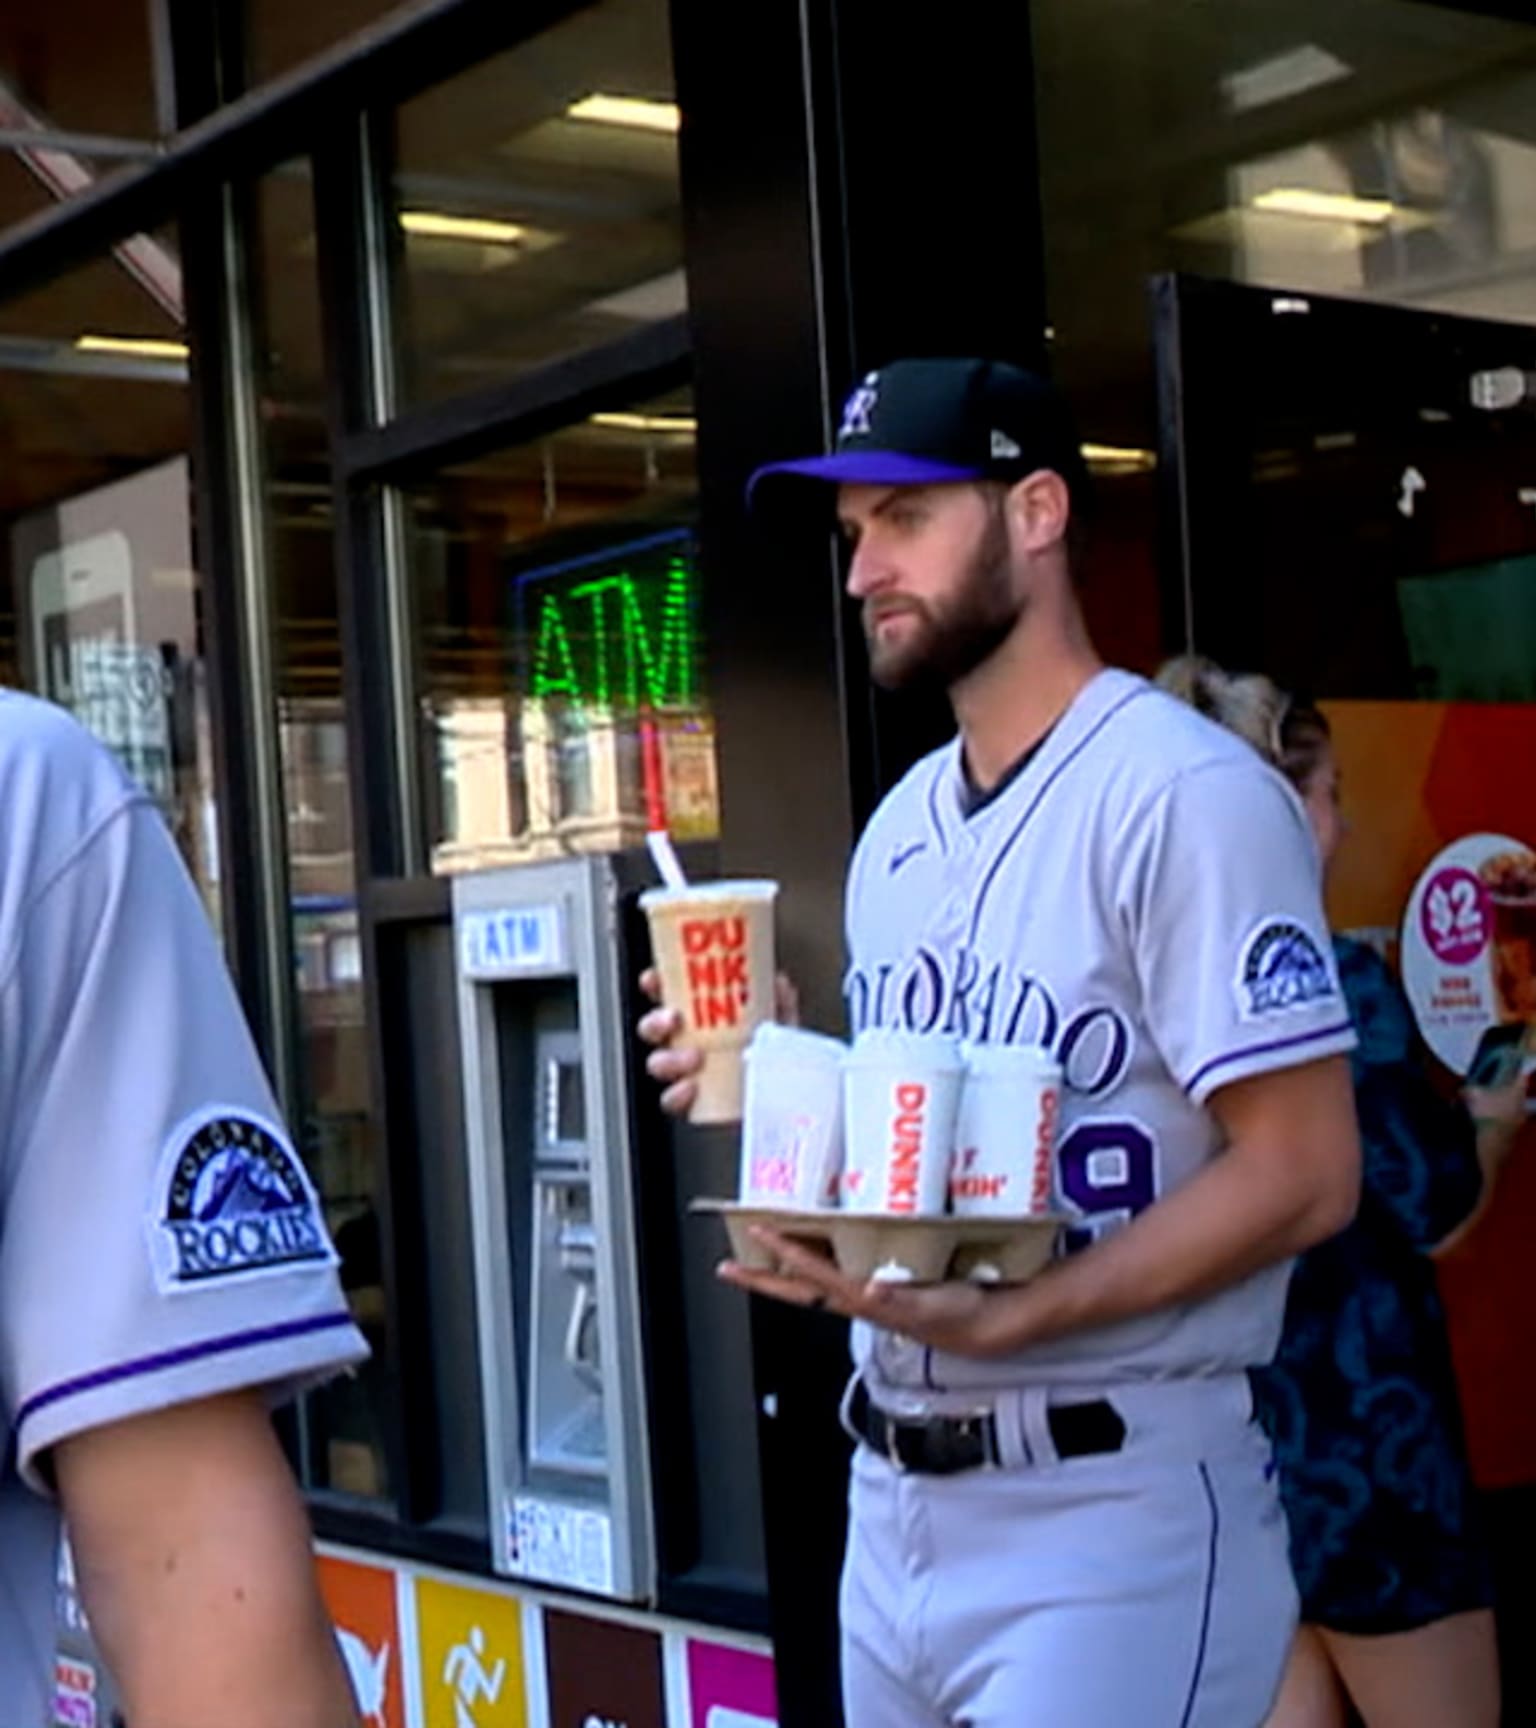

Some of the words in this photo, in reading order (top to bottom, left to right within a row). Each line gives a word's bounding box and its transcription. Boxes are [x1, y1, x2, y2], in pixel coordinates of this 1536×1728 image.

[533, 556, 690, 710] ATM
[484, 916, 541, 961] ATM
[682, 916, 746, 954] DU
[173, 1206, 321, 1271] ROCKIES
